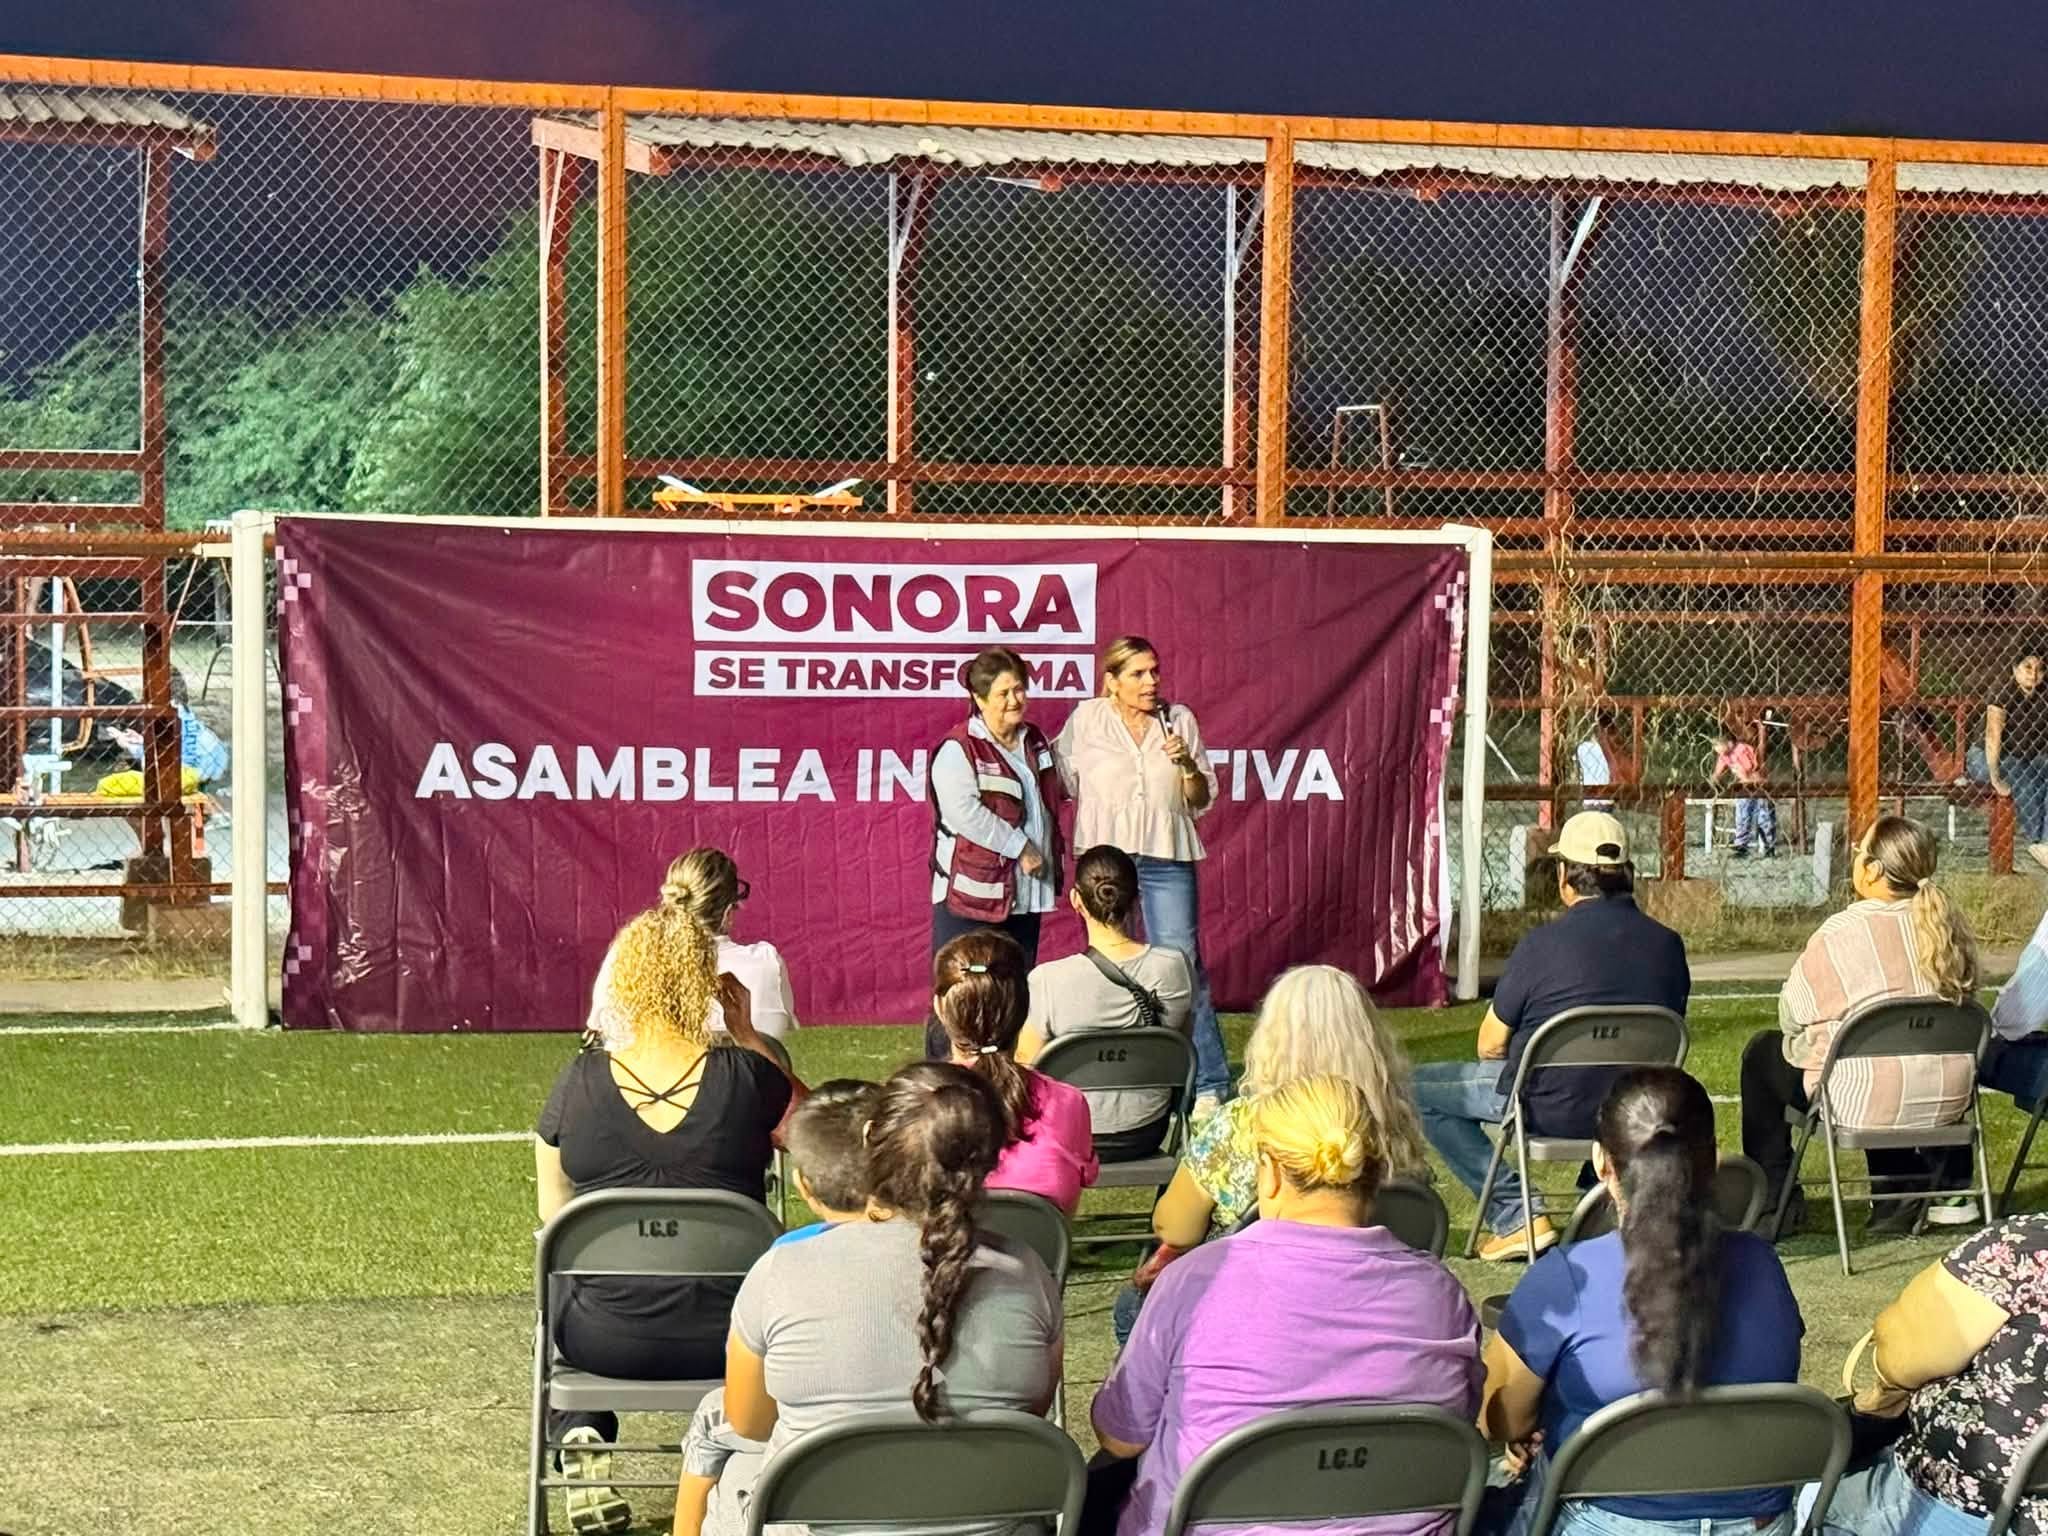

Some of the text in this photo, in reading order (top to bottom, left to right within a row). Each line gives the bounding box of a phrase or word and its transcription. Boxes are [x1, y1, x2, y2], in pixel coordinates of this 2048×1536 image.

[705, 571, 1083, 633] SONORA
[708, 657, 1087, 692] SE TRANSFMA
[414, 742, 837, 801] ASAMBLEA
